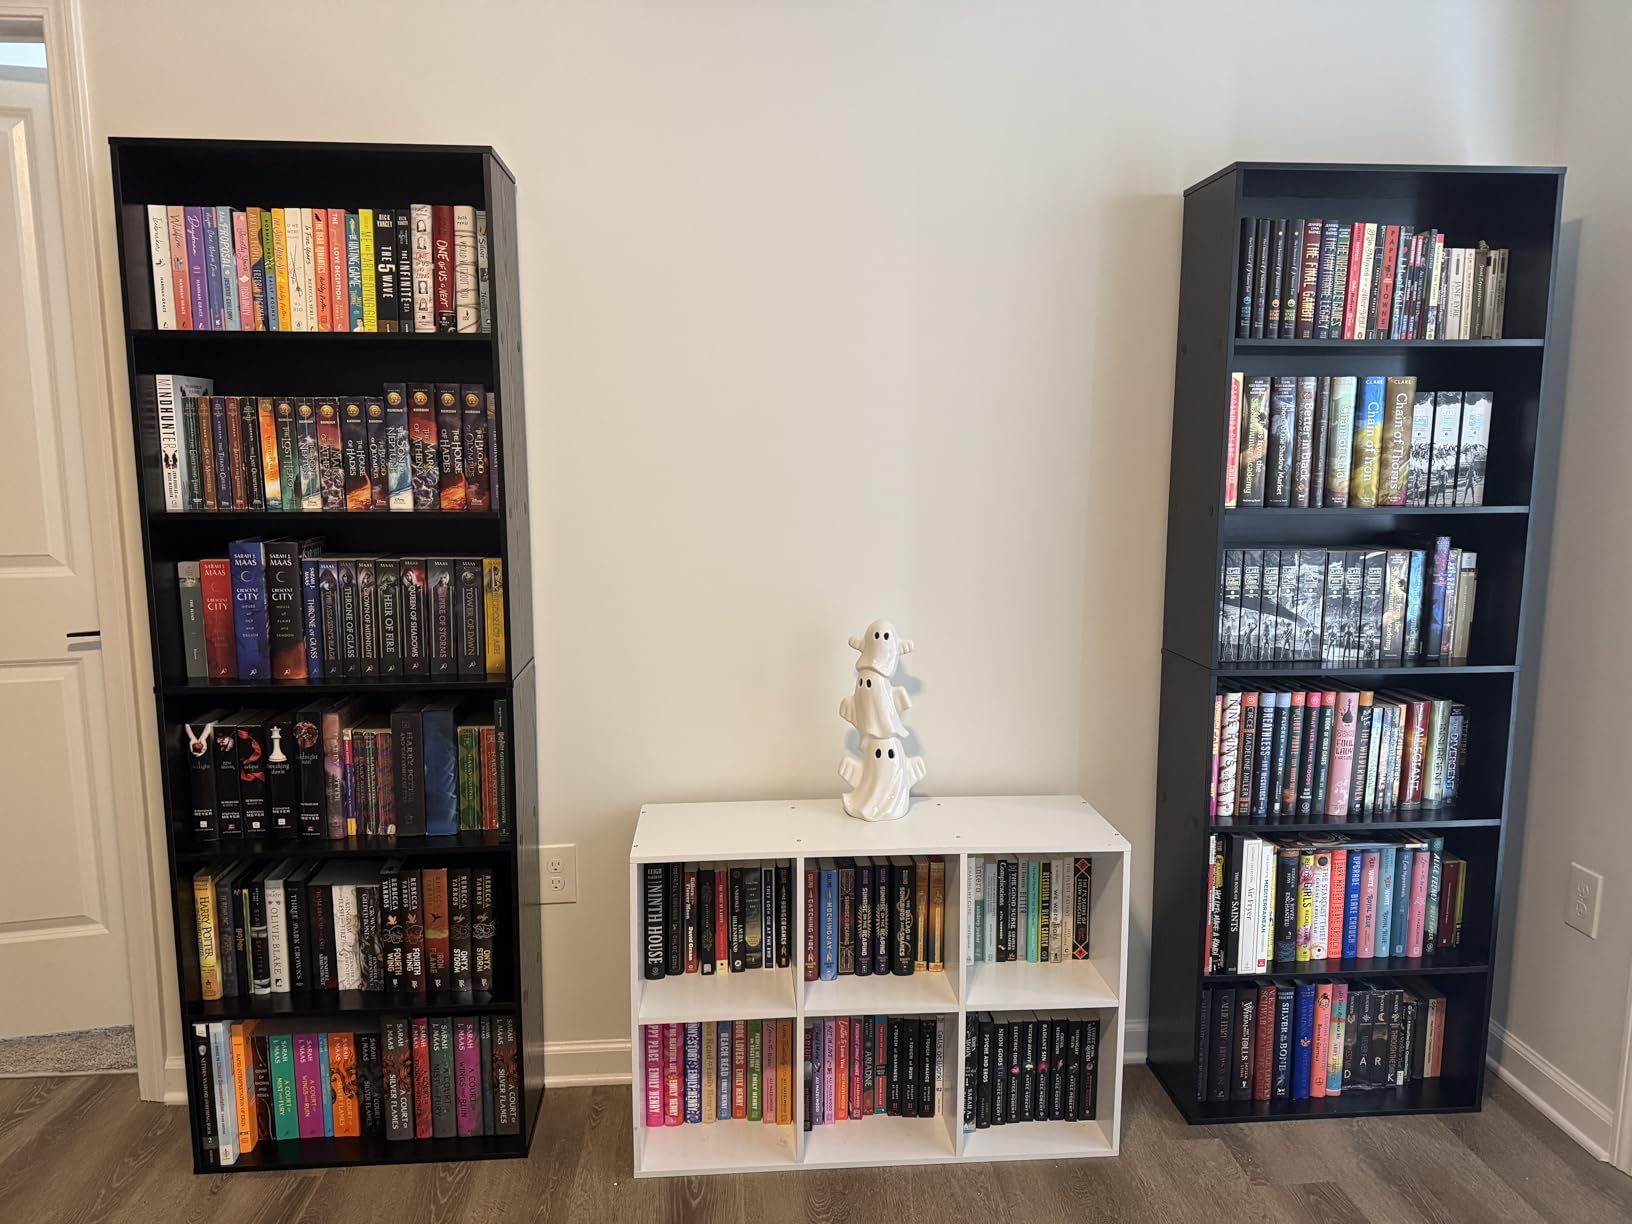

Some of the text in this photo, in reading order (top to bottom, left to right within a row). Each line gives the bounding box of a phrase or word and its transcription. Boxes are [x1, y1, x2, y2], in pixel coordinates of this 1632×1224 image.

[378, 213, 390, 221] RICK
[221, 222, 231, 268] PROPOSAL
[348, 241, 360, 265] HATING
[381, 246, 392, 262] THE
[436, 239, 450, 262] ONE
[334, 265, 342, 300] DECEPTION
[349, 266, 361, 288] GAME
[382, 275, 393, 299] WAVE
[400, 261, 412, 303] INFINITE
[438, 270, 448, 284] US
[1301, 243, 1320, 322] THE FINAL GAMBIT
[1318, 238, 1337, 329] THE HAWTHORNE LEGACY
[1331, 241, 1350, 327] THE INHERITANCE GAMES
[439, 289, 449, 308] NEXT
[157, 378, 177, 449] MINDHUNTER
[413, 423, 424, 476] OF ATHENA
[440, 428, 451, 473] OF HADES
[1300, 402, 1313, 481] Better in Black
[1363, 402, 1380, 481] Chain of Iron
[1390, 393, 1408, 489] Chain of Thorns
[452, 442, 463, 474] HOUSE
[204, 569, 226, 577] MAAS
[236, 593, 259, 601] CITY
[271, 593, 294, 601] CITY
[307, 598, 317, 628] THRONE
[344, 587, 355, 659] THRONE OF GLASS
[384, 594, 395, 653] HEIR OF FIRE
[410, 611, 417, 621] OF
[310, 637, 319, 659] GLASS
[410, 621, 419, 658] SHADOWS
[1228, 699, 1238, 728] NINE
[1246, 706, 1254, 728] CIRCE
[1260, 707, 1274, 756] BREATHLESS
[1241, 733, 1252, 797] MADELINE MILLER
[1411, 726, 1425, 791] ALLEGIANT
[1446, 733, 1458, 790] DIVERGENT
[1321, 868, 1329, 881] THE
[1352, 856, 1360, 886] UPGRADE
[1431, 853, 1440, 902] ALICE FEENEY
[391, 878, 399, 911] REBECCA
[410, 877, 418, 911] REBECCA
[1246, 900, 1254, 921] Fryer
[1261, 879, 1269, 934] MEDITERRANEAN
[1303, 882, 1312, 908] GIRLS
[1320, 883, 1328, 916] STARDUST
[200, 896, 214, 959] HARRY POTTER
[648, 881, 663, 964] NINTH HOUSE
[1230, 900, 1239, 933] SAINTS
[1348, 894, 1358, 944] BLAKE CROUCH
[270, 907, 282, 975] OLIVIE BLAKE
[387, 953, 395, 973] WING
[393, 948, 402, 976] FOURTH
[406, 953, 414, 972] WING
[412, 948, 421, 976] FOURTH
[453, 948, 461, 973] STORM
[460, 950, 468, 971] ONYX
[476, 947, 484, 973] STORM
[483, 949, 491, 970] ONYX
[1278, 1002, 1289, 1071] SILVER BONE
[498, 1069, 506, 1094] SILVER
[865, 1051, 873, 1087] ARIADNE
[1344, 1057, 1394, 1082] D A R K
[389, 1074, 399, 1130] SILVER FLAMES
[649, 1067, 660, 1113] EMILY HENRY
